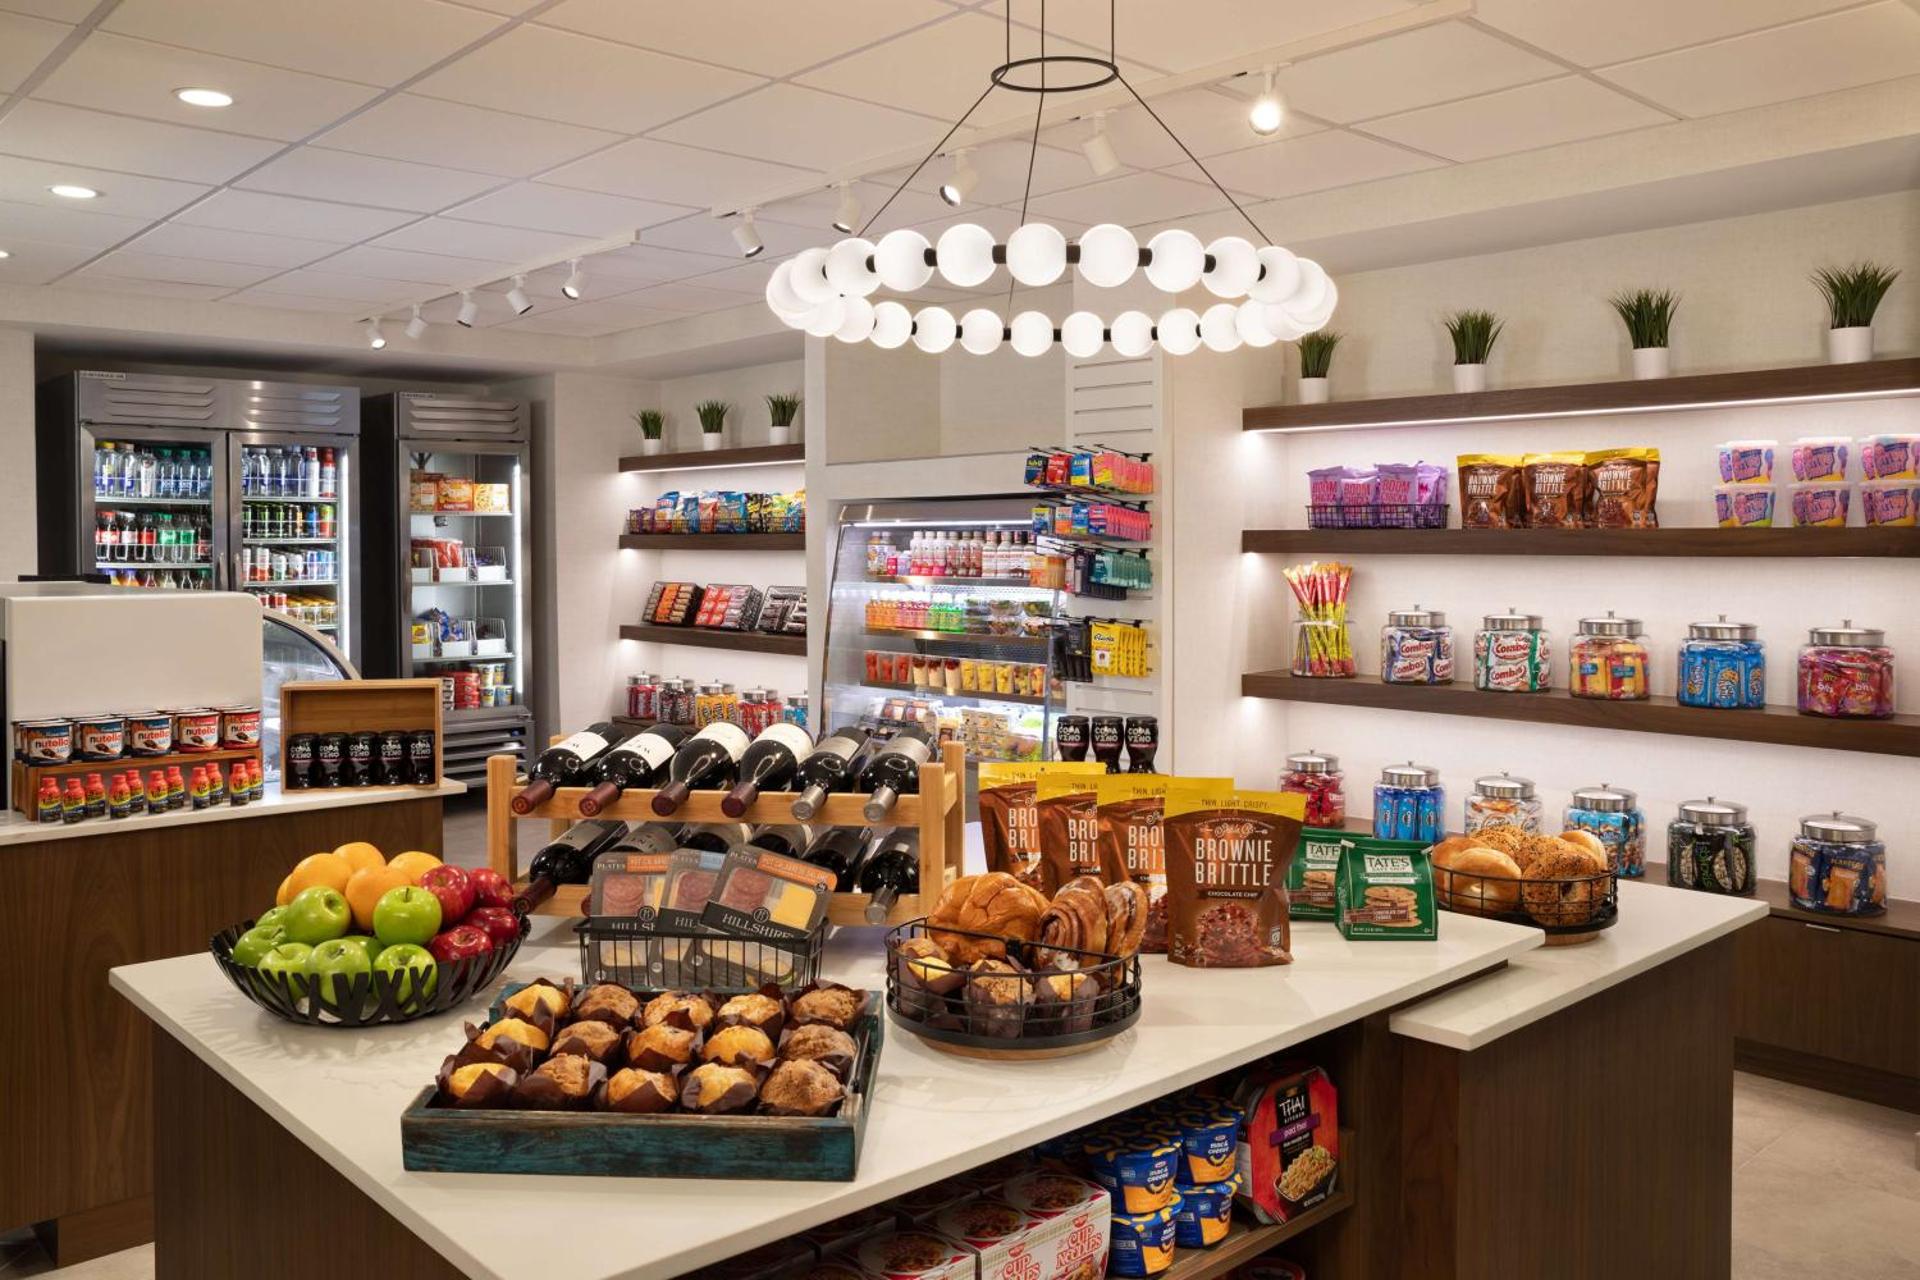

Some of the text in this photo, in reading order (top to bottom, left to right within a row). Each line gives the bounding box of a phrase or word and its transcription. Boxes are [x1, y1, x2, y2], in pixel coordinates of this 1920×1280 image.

[138, 730, 170, 740] nutella
[186, 726, 216, 736] nutella
[1058, 726, 1081, 735] COPA
[1094, 726, 1118, 735] COPA
[1127, 727, 1151, 735] COPA
[35, 737, 70, 749] nutella
[90, 733, 122, 743] nutella
[1059, 734, 1081, 742] VINO
[1095, 734, 1119, 742] VINO
[1128, 735, 1152, 743] VINO
[1201, 799, 1217, 807] THIN
[1220, 799, 1240, 808] LIGHT
[1195, 837, 1273, 863] BROWNIE
[1367, 857, 1410, 868] TATE'S
[1195, 861, 1274, 887] BRITTLE
[1279, 1096, 1305, 1117] THAI
[1068, 1224, 1095, 1248] CUP
